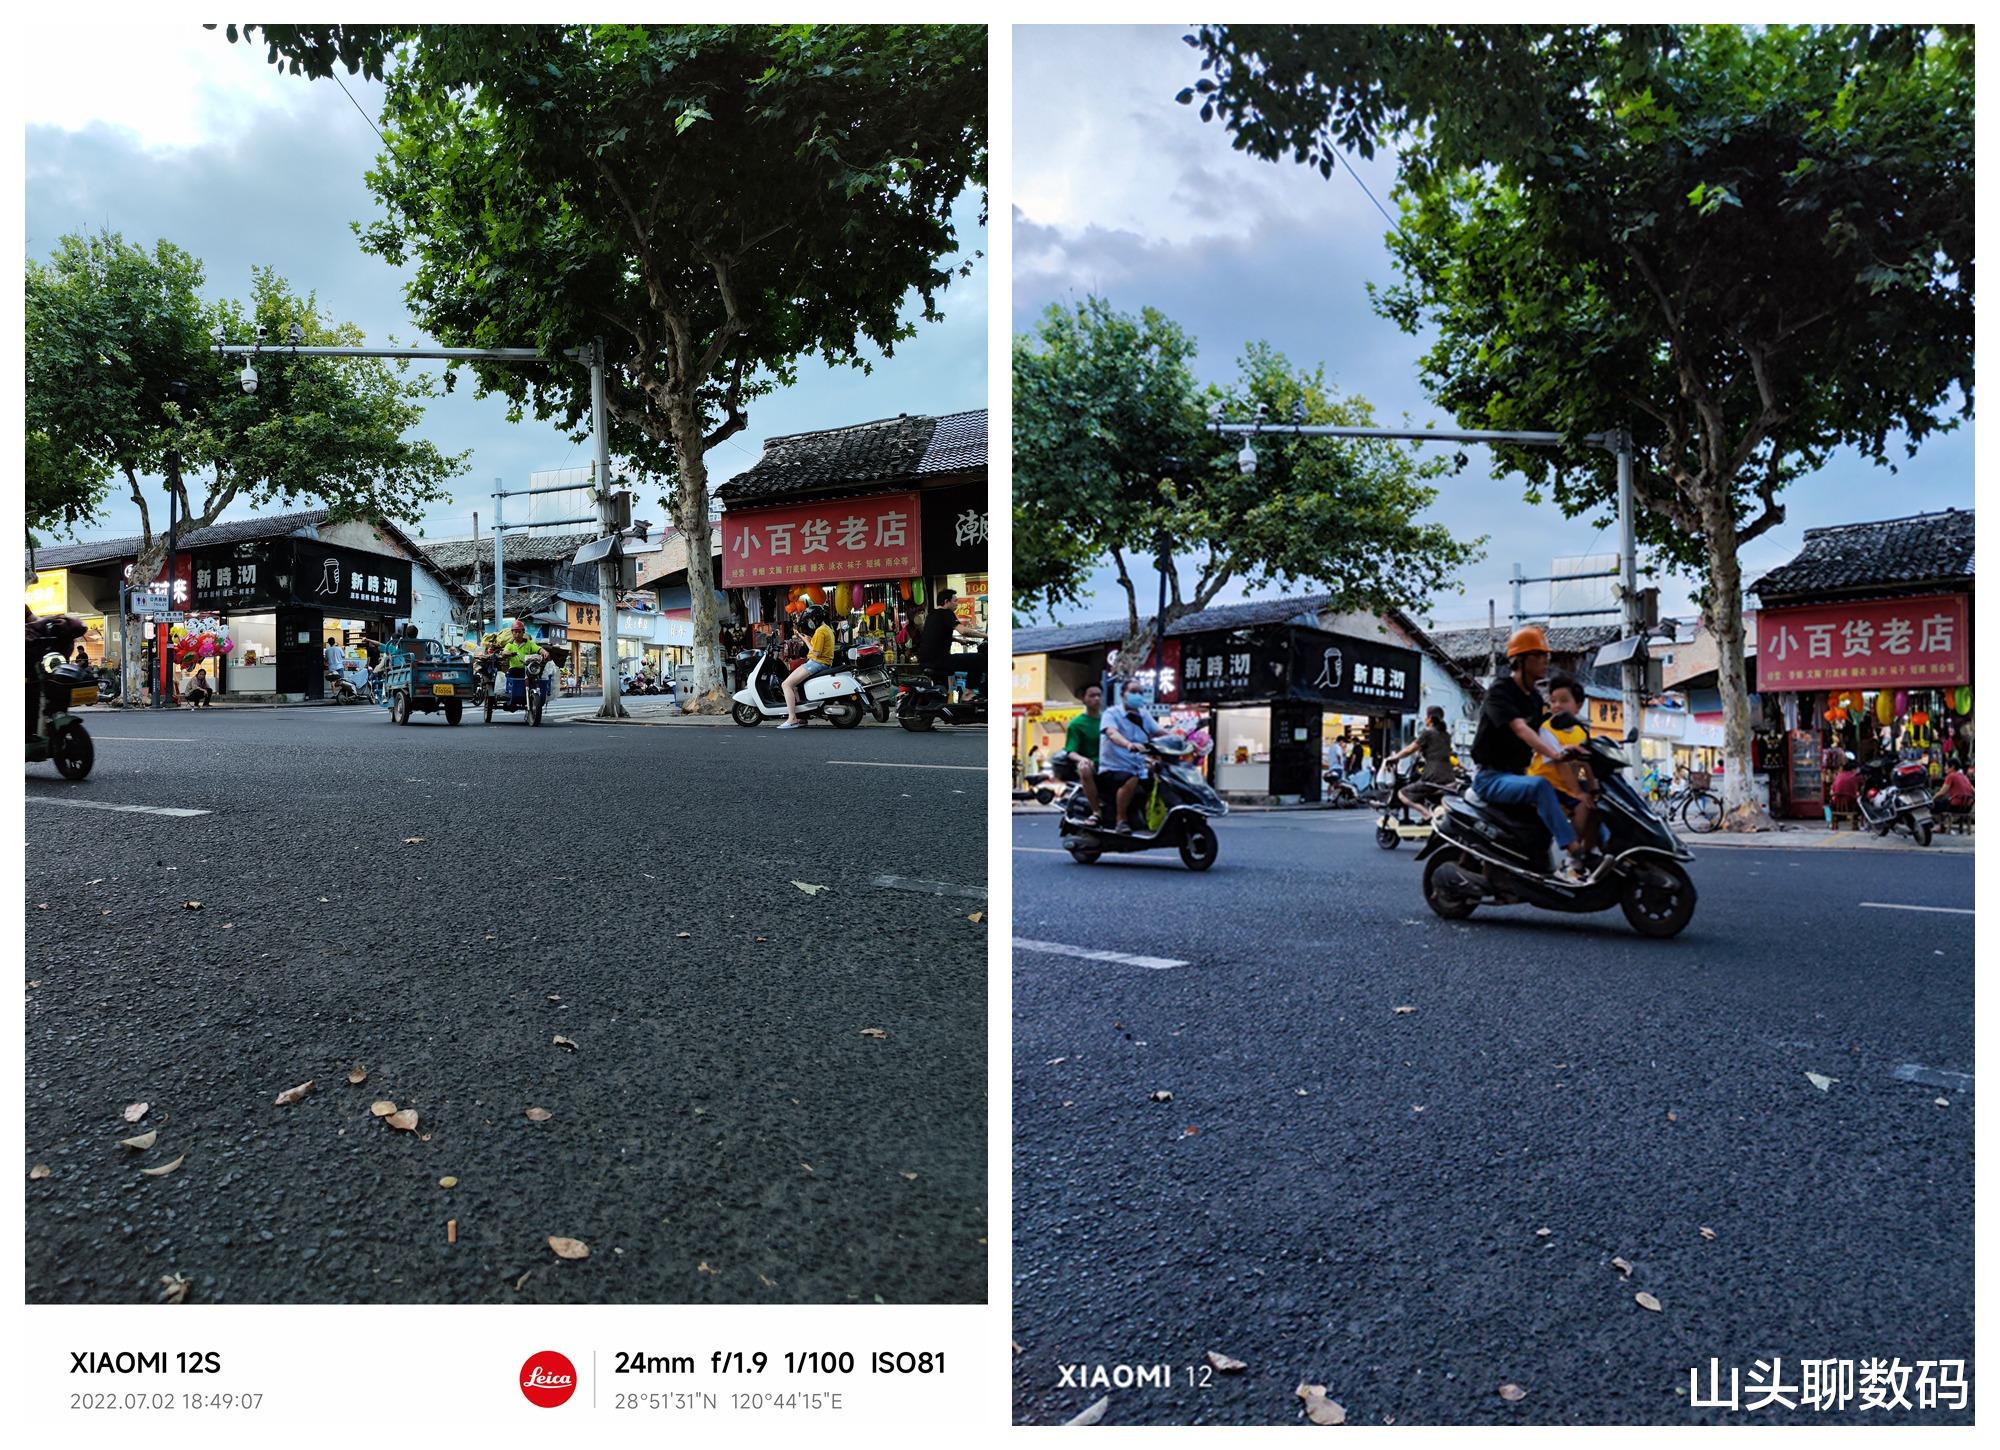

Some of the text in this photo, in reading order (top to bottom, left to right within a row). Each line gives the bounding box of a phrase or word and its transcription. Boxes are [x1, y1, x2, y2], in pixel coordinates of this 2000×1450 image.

[733, 511, 908, 560] 小百货老店
[1768, 614, 1955, 662] 小百货老店
